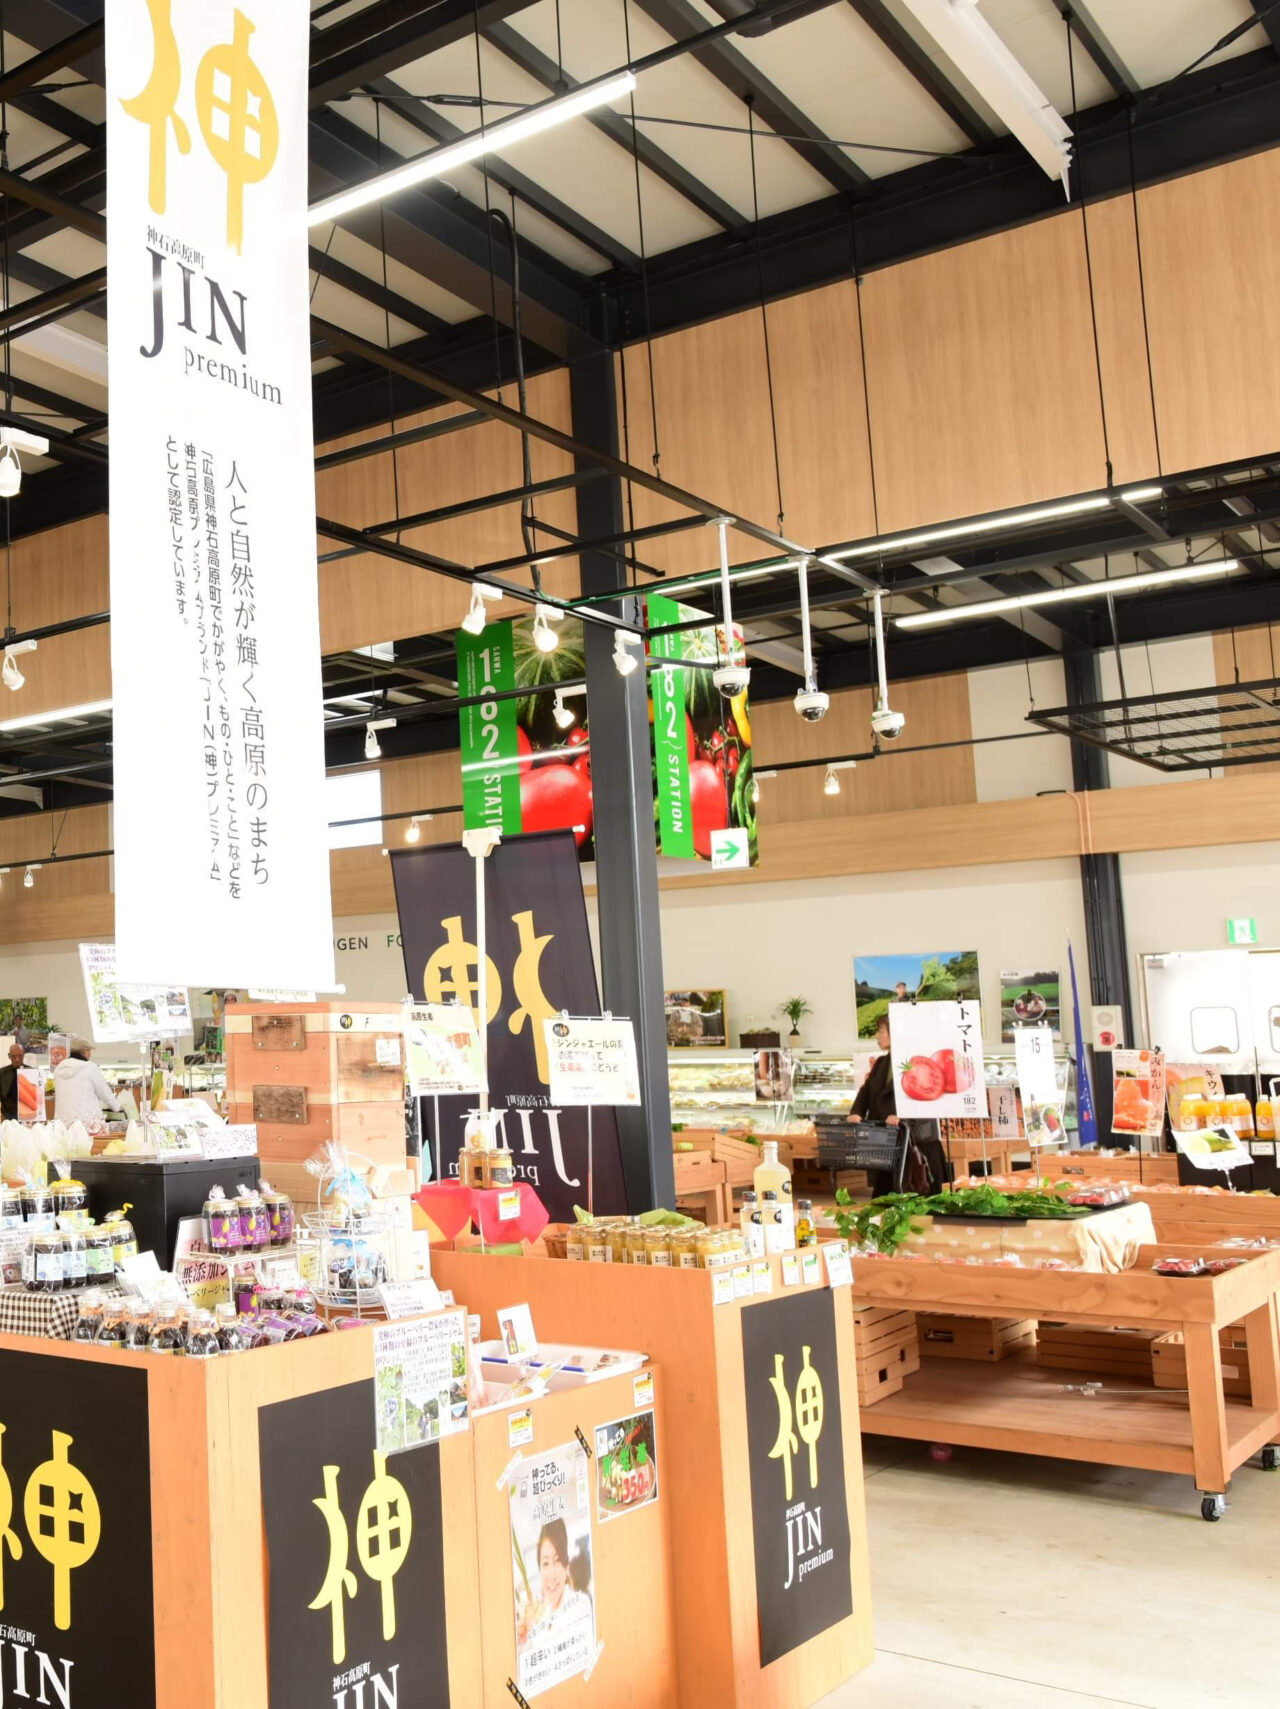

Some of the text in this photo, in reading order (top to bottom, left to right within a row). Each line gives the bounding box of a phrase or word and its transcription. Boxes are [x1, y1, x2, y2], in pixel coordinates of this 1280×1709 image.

[146, 224, 206, 271] 神石高原町
[139, 246, 249, 359] JIN
[184, 345, 284, 405] premium
[166, 434, 188, 625] として認定しています。
[224, 459, 270, 886] 人と自然が輝く高原のまち
[493, 646, 501, 674] SANWA
[479, 648, 503, 836] 182 STATIO
[667, 753, 683, 834] STATION
[333, 936, 369, 951] GEN
[957, 1007, 973, 1054] トマト
[1031, 1036, 1041, 1054] 15
[1151, 1056, 1162, 1090] みかん
[963, 1097, 976, 1105] 182
[784, 1506, 822, 1590] JIN
[798, 1547, 834, 1582] premium
[332, 1661, 371, 1692] 神石高原町
